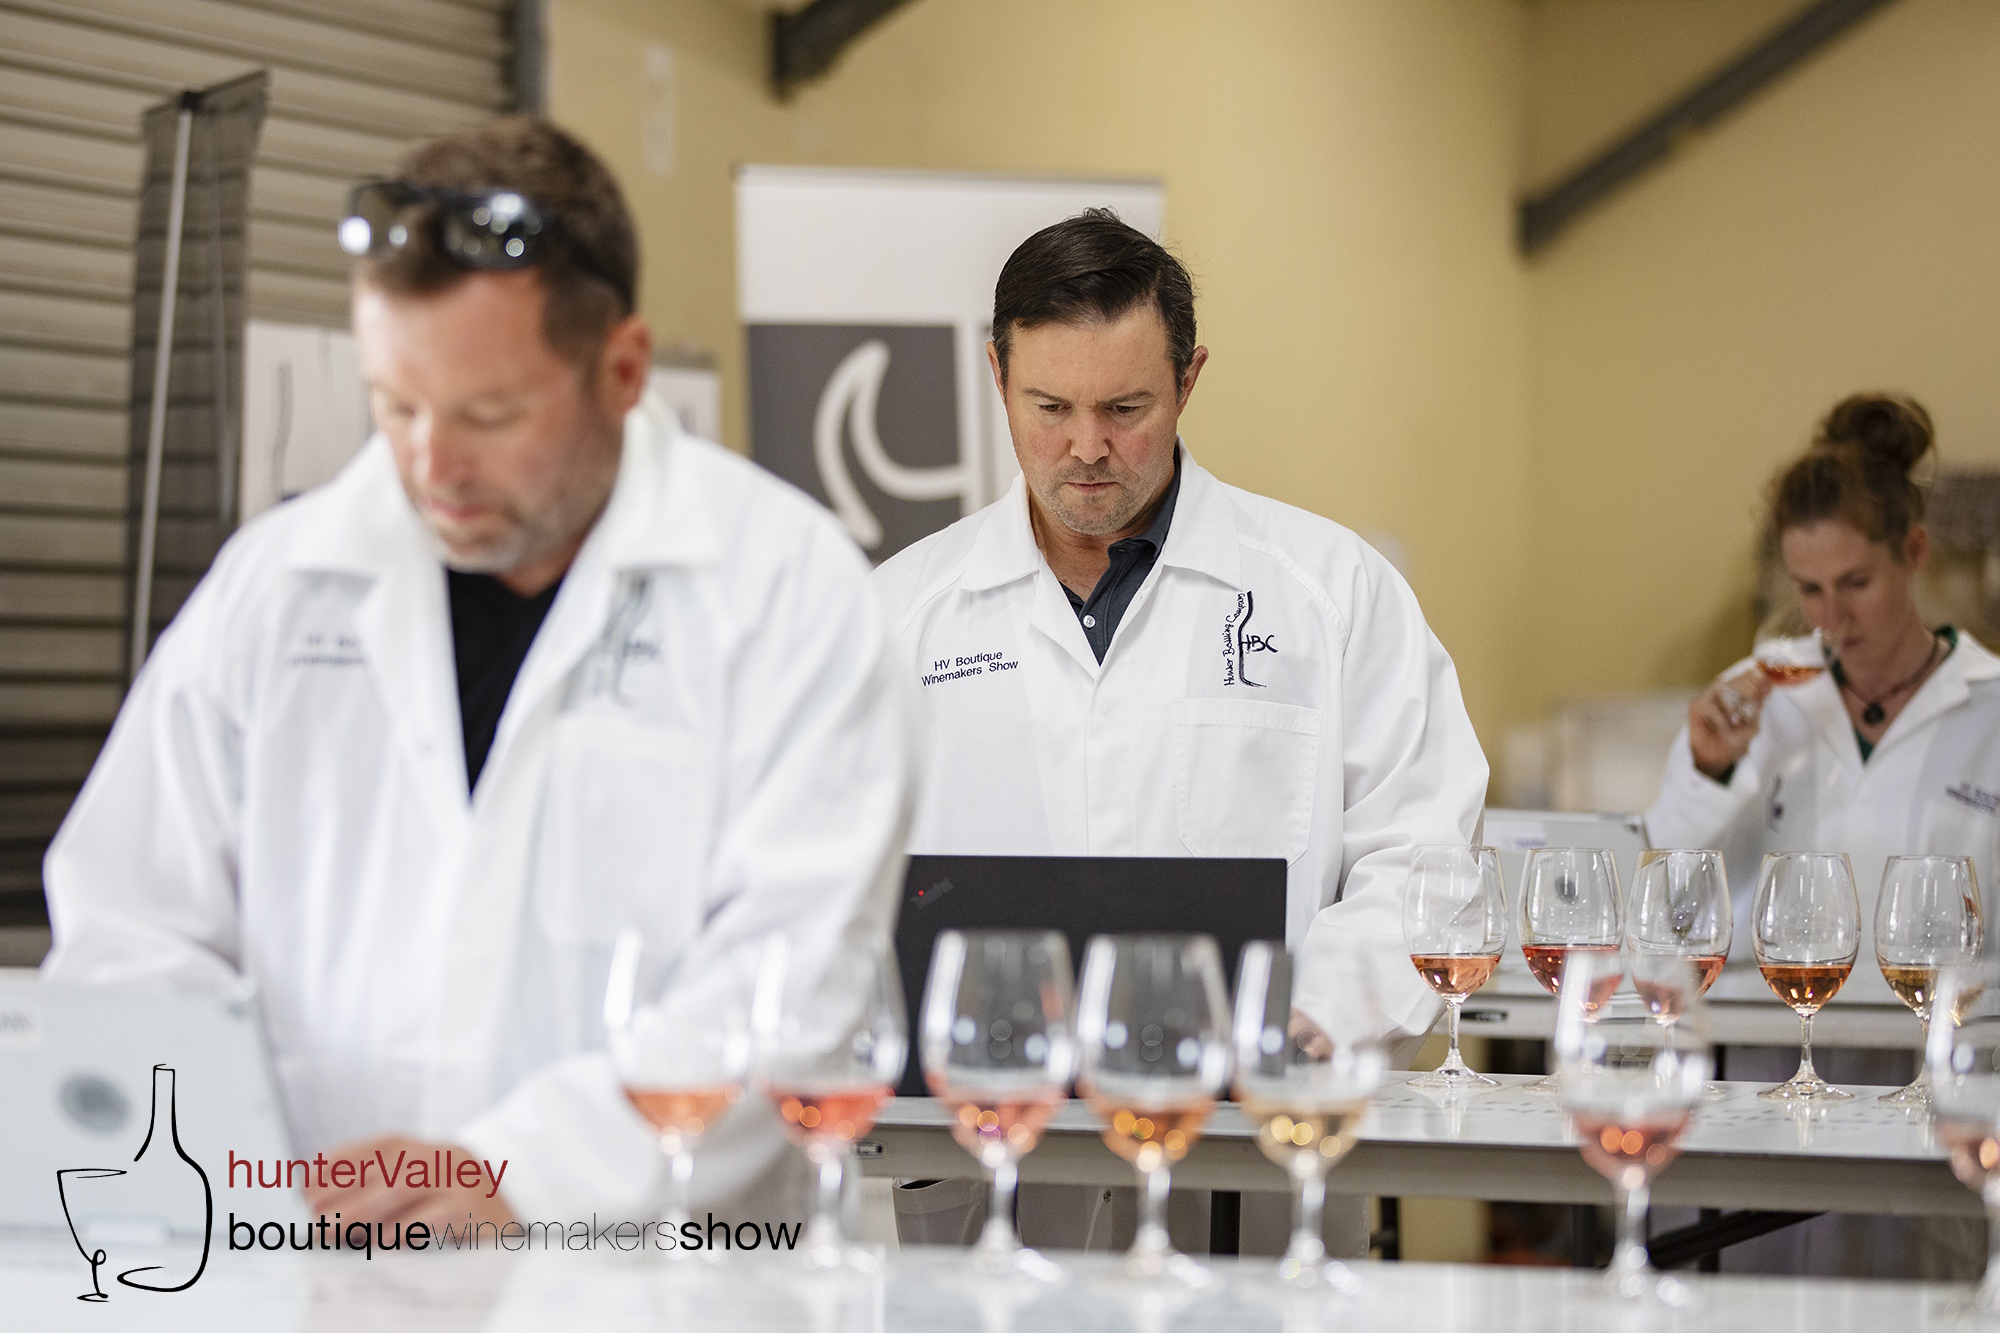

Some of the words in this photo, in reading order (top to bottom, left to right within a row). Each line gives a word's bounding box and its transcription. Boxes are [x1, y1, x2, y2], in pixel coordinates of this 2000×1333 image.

[1239, 634, 1278, 654] HBC
[934, 659, 951, 671] HV
[955, 651, 1003, 667] Boutique
[921, 666, 983, 687] Winemakers
[988, 660, 1019, 672] Show
